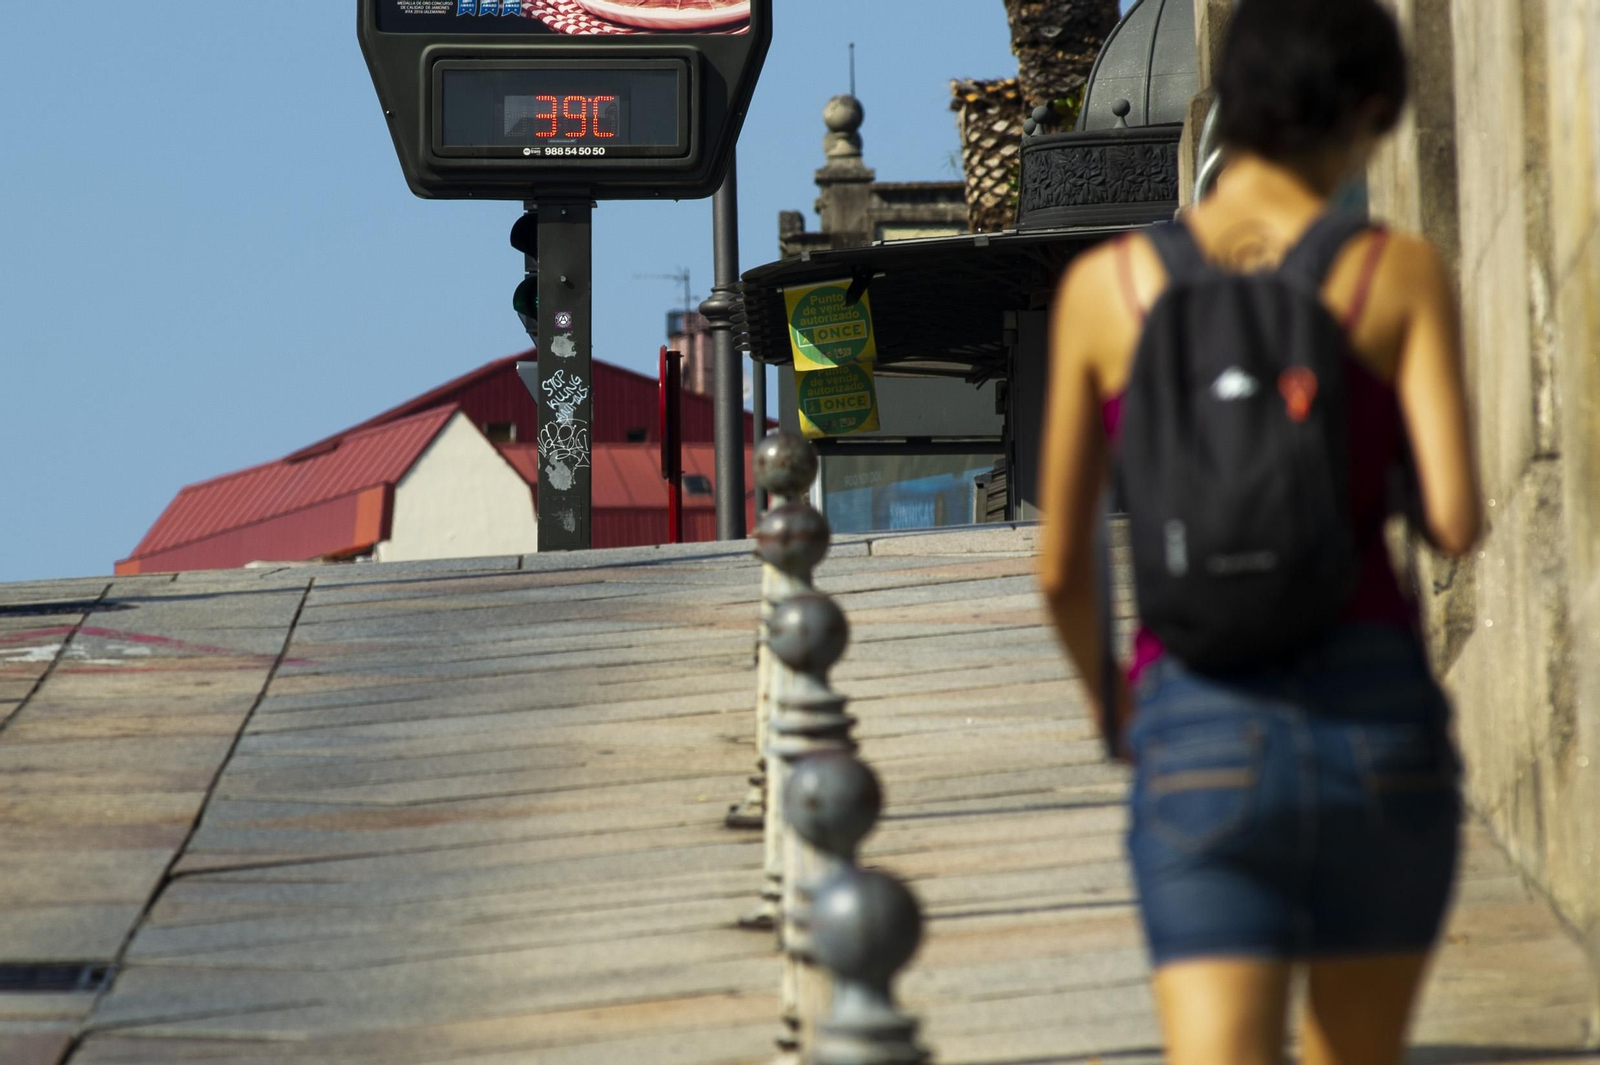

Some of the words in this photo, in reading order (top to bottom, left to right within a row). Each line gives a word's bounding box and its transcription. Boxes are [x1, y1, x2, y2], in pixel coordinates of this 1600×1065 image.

[545, 147, 563, 155] 988
[565, 147, 577, 155] 54
[578, 147, 591, 155] 50
[592, 147, 605, 155] 50
[810, 294, 844, 305] Punto
[802, 306, 816, 316] de
[820, 301, 854, 314] vend
[800, 310, 860, 326] autorizado
[818, 324, 862, 340] ONCE
[542, 369, 565, 396] STOP
[810, 377, 823, 387] de
[826, 373, 859, 384] venda
[807, 382, 864, 396] autorizado
[824, 396, 866, 410] ONCE
